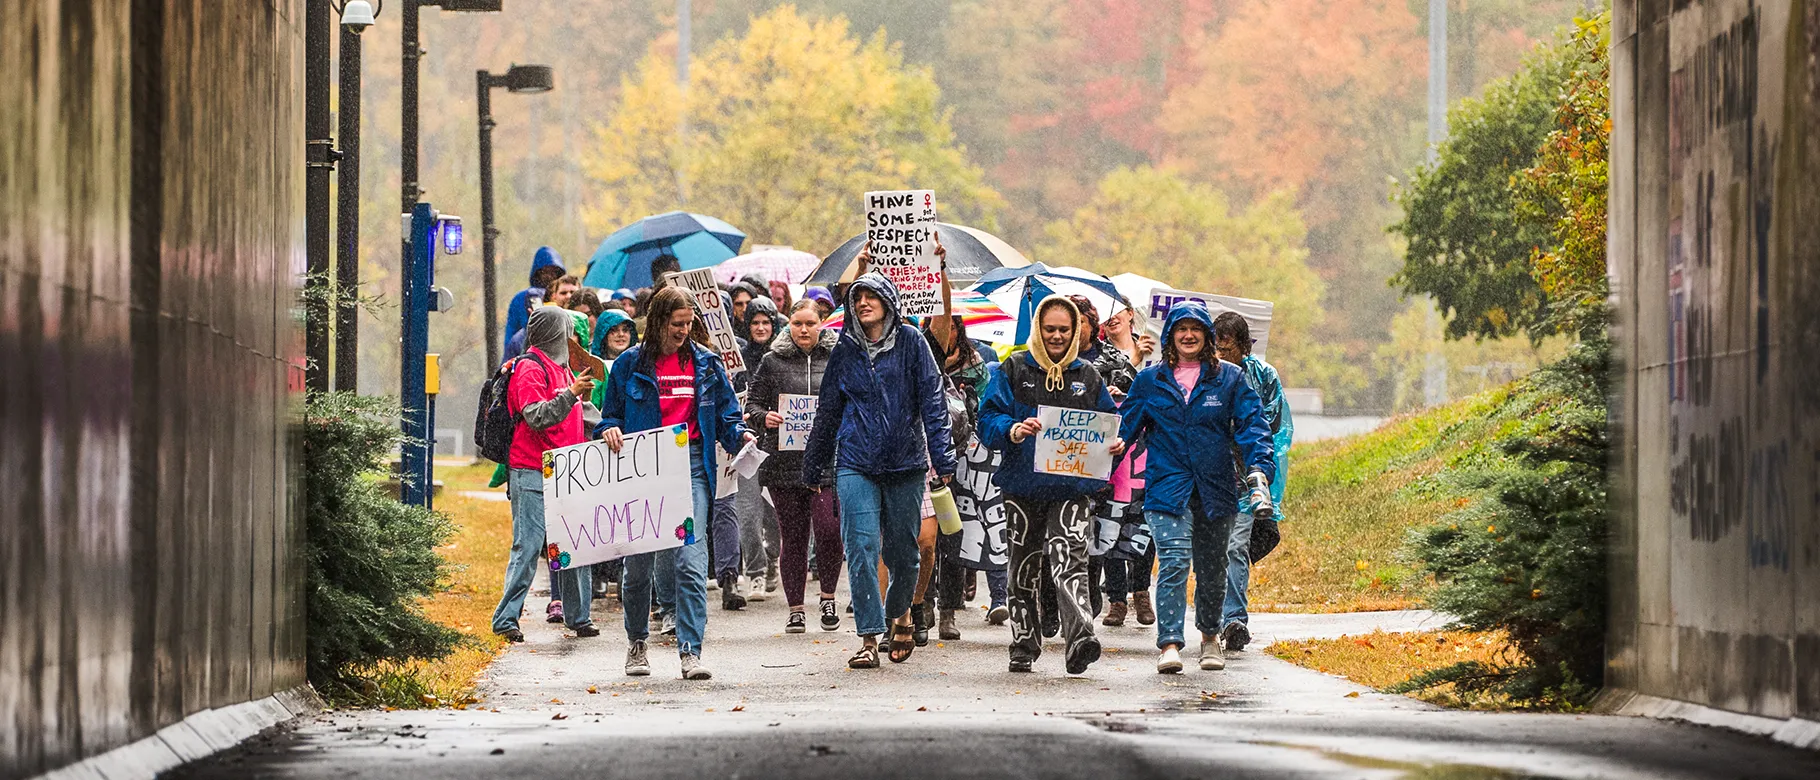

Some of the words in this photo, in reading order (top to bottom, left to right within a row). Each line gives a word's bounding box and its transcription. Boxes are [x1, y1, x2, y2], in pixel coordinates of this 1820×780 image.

[870, 194, 914, 208] HAVE
[867, 211, 915, 227] SOME
[869, 242, 922, 256] WOMEN
[685, 271, 715, 291] WILL
[927, 272, 941, 284] BS
[702, 290, 720, 310] GO
[922, 290, 936, 299] DAY
[907, 305, 934, 315] AWAY!
[715, 332, 732, 350] TO
[789, 398, 812, 410] NOT
[1059, 409, 1097, 427] KEEP
[786, 434, 794, 446] A
[1043, 427, 1105, 443] ABORTION
[1056, 440, 1088, 455] SAFE
[554, 430, 664, 498] PROTECT
[1046, 459, 1093, 476] LEGAL
[561, 496, 664, 550] WOMEN
